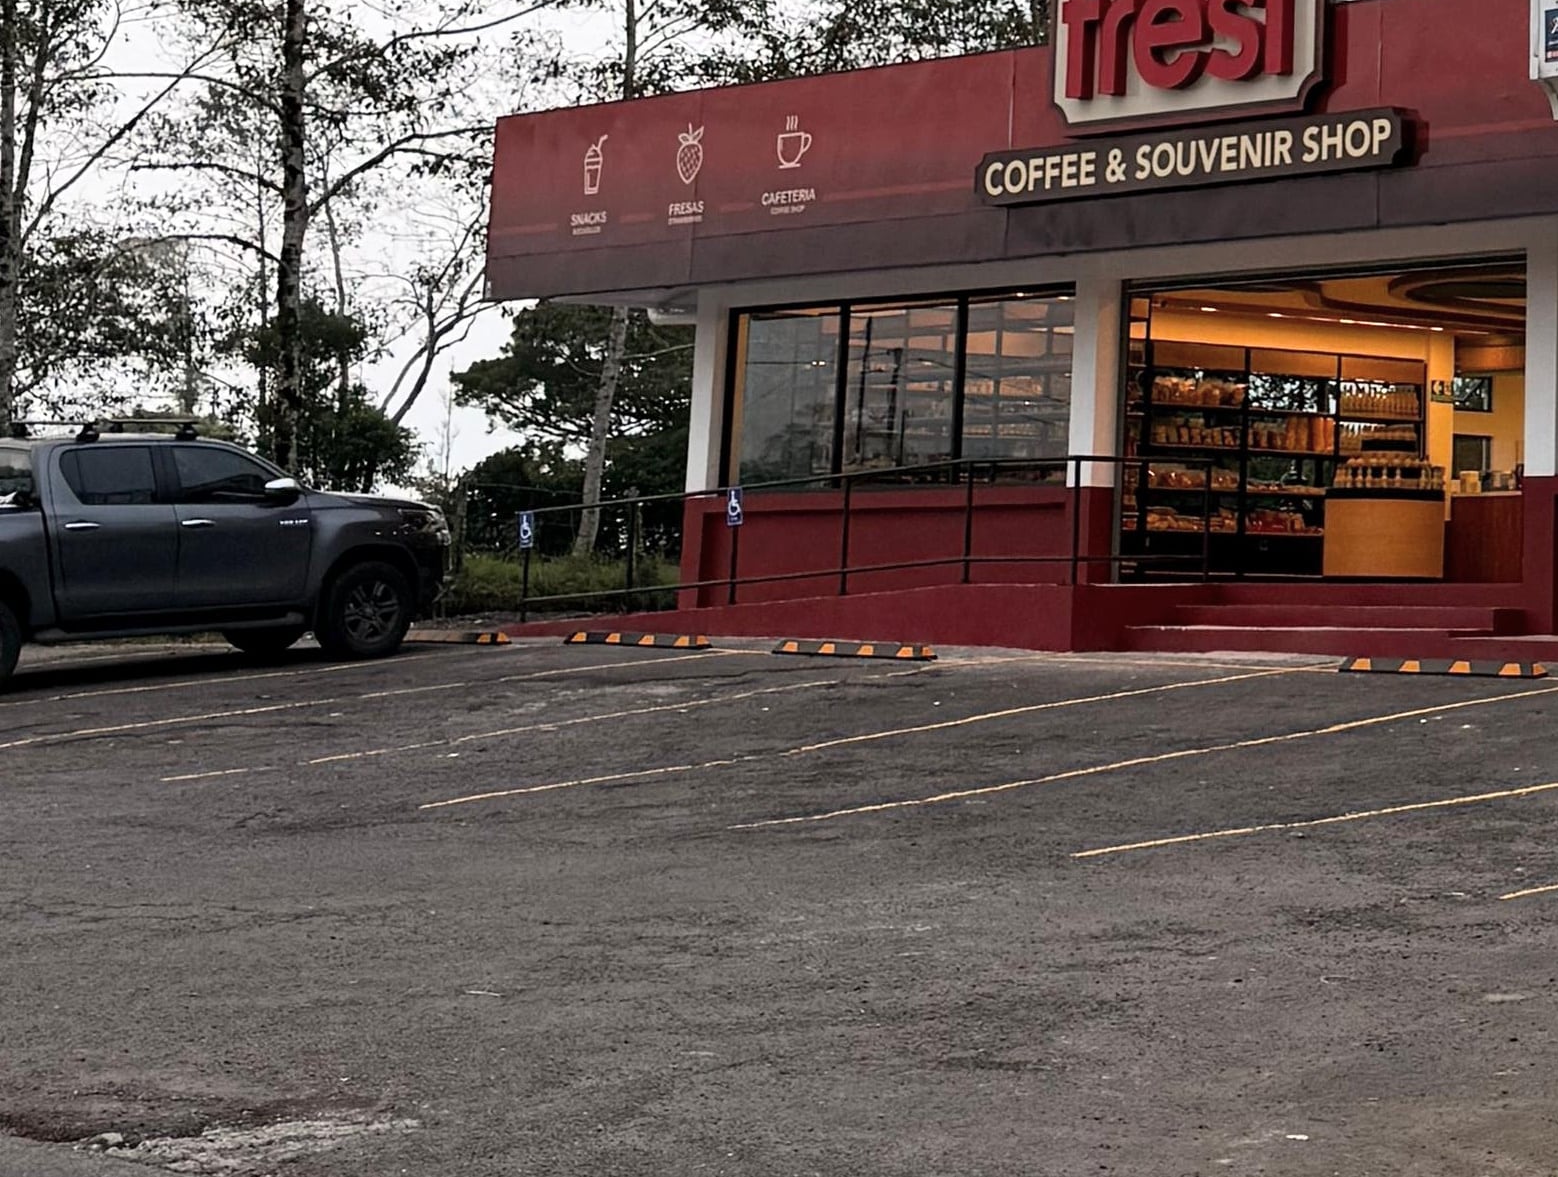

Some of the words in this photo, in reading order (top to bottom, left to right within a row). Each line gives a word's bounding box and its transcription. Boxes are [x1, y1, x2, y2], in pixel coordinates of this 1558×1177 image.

[984, 152, 1096, 197] COFFEE
[1105, 147, 1126, 184] &
[1134, 130, 1293, 180] SOUVENIR
[1302, 118, 1392, 164] SHOP
[761, 188, 816, 206] CAFETERIA
[668, 201, 705, 216] FRESAS
[570, 211, 607, 226] SNACKS
